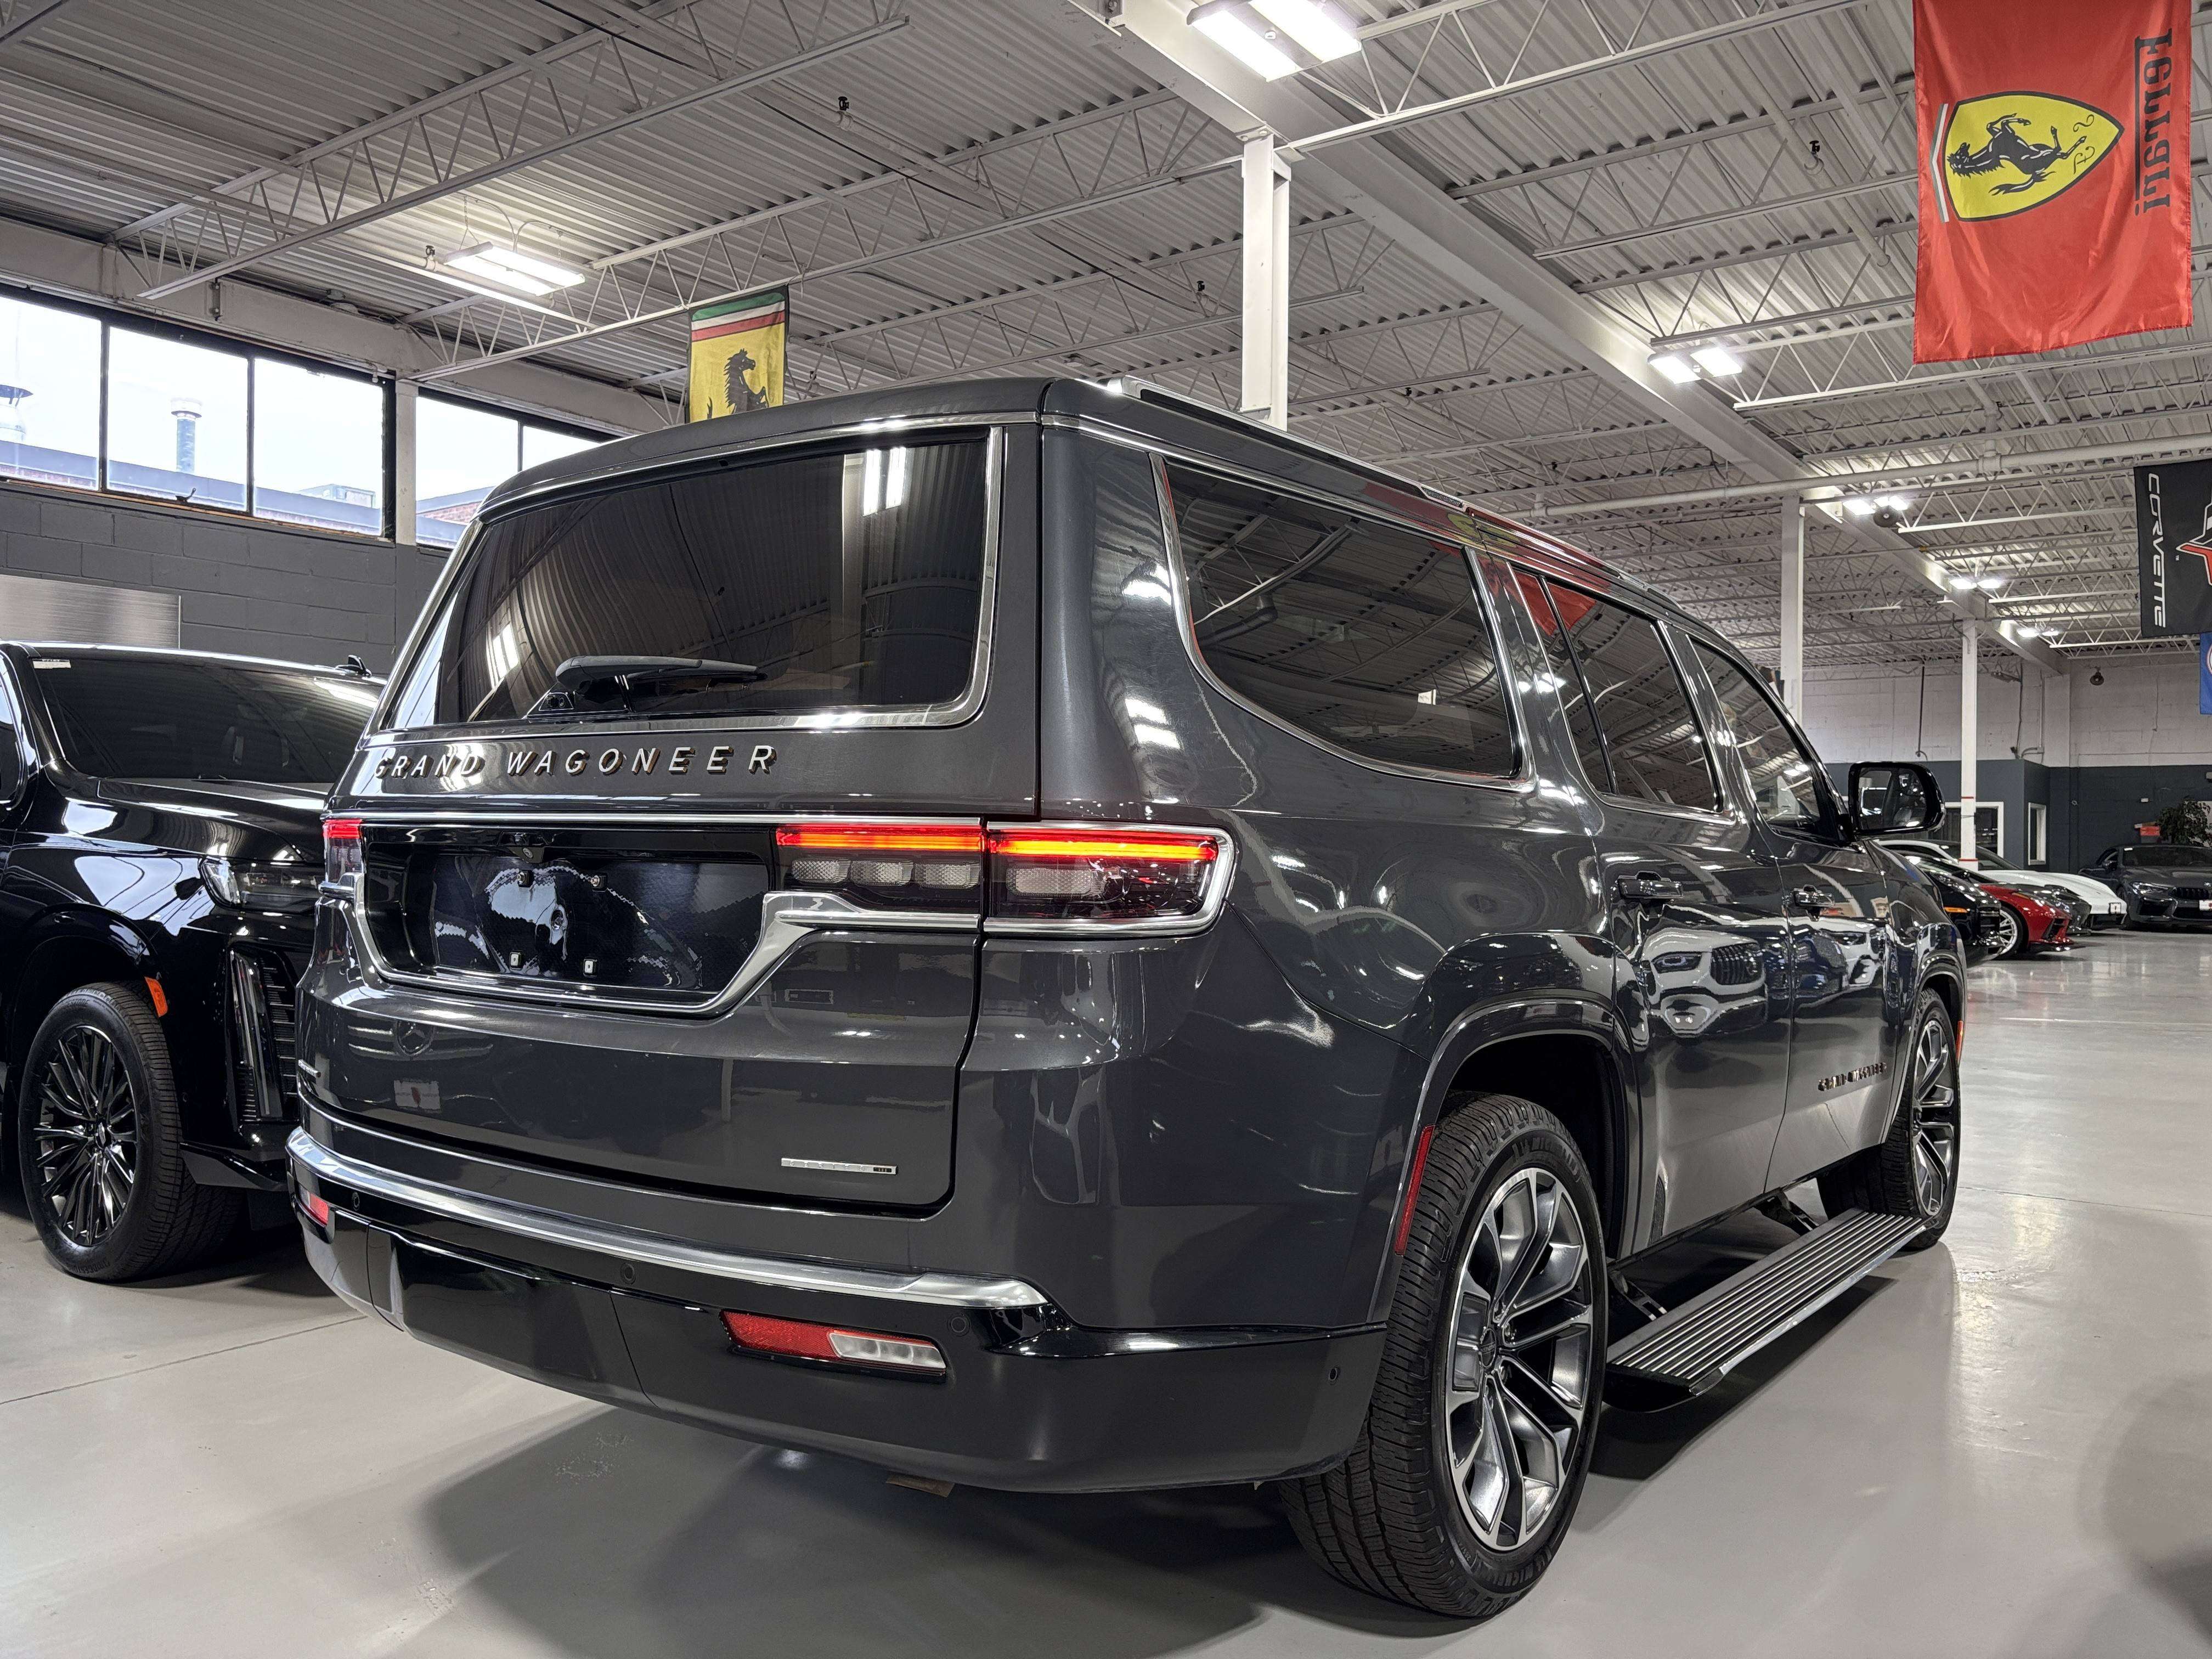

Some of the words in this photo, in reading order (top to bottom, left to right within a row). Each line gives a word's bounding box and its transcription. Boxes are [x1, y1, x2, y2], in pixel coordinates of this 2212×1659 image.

[2148, 473, 2166, 628] CORVETTE
[374, 754, 486, 779] GRAND
[506, 745, 777, 777] WAGONEER
